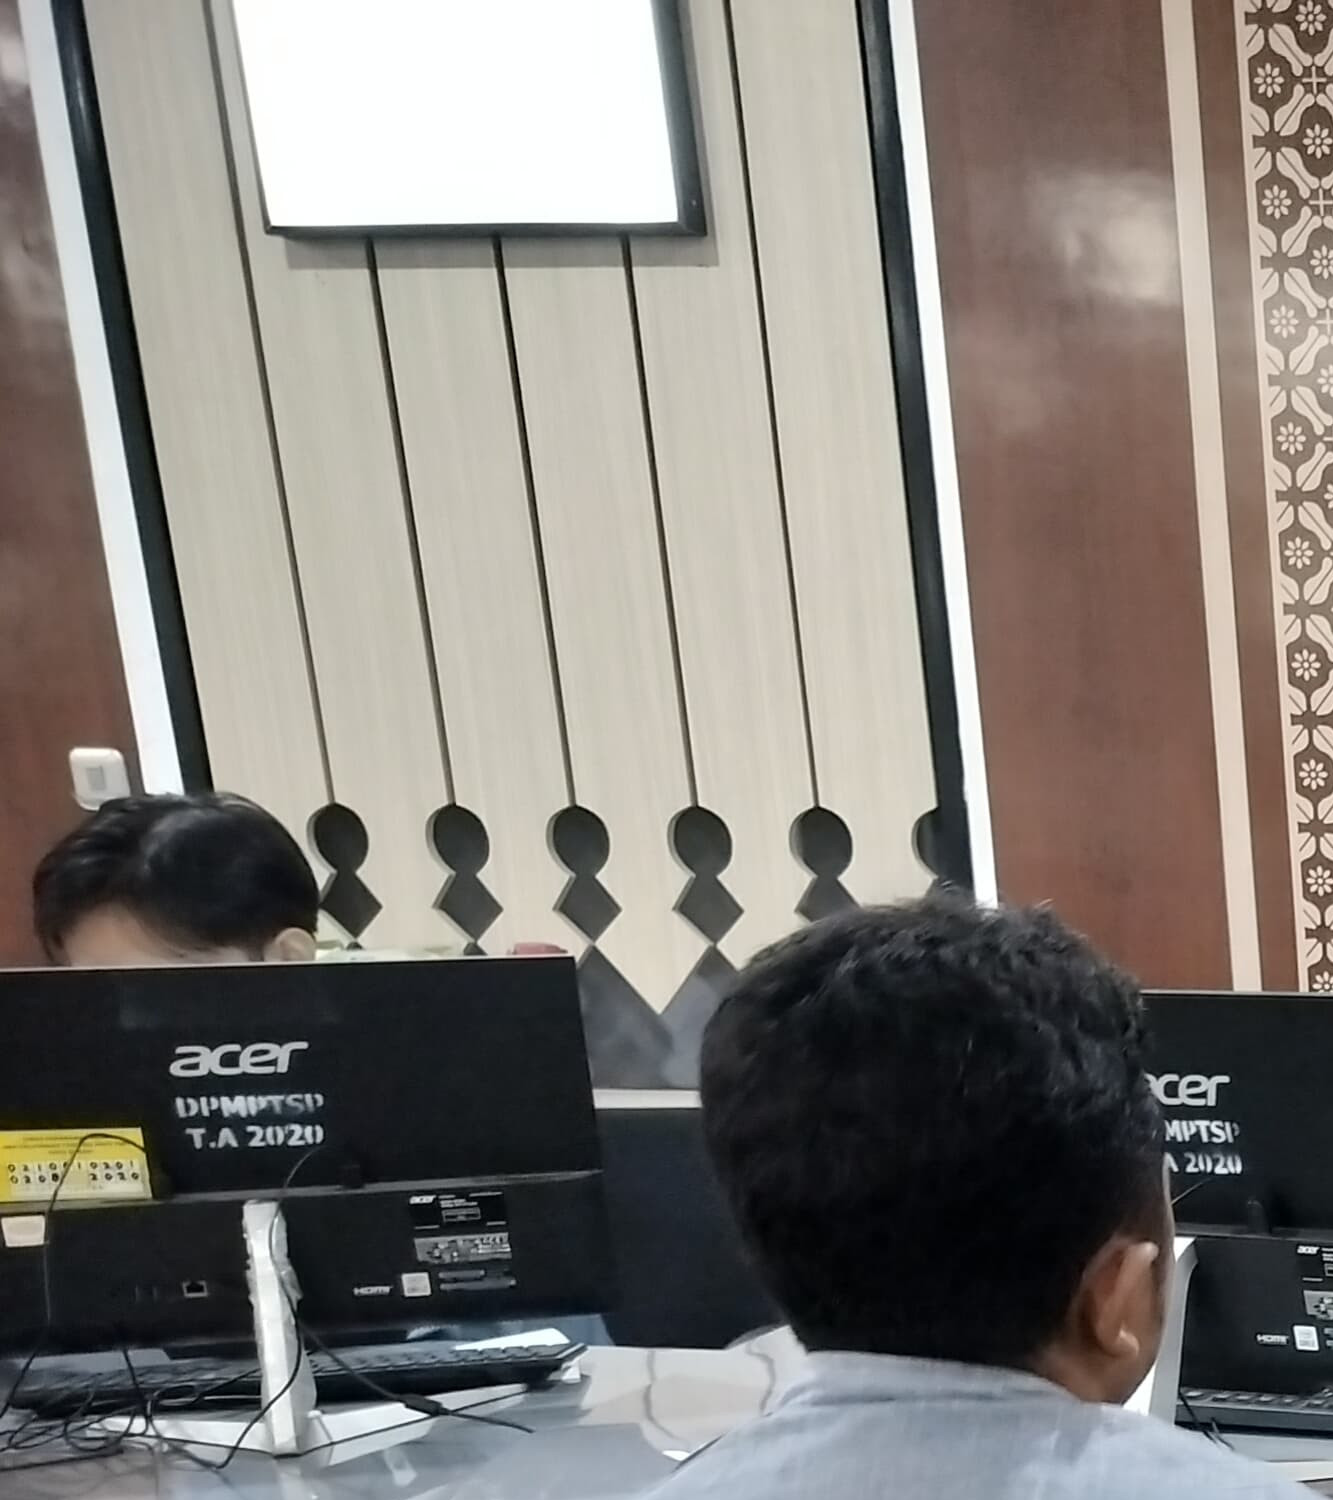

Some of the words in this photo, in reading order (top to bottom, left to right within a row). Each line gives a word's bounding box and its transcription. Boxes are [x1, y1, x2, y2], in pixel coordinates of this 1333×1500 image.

[169, 1041, 309, 1077] acer
[175, 1093, 324, 1118] DPMPTSP
[246, 1123, 324, 1147] 2020
[1184, 1152, 1242, 1175] 2020
